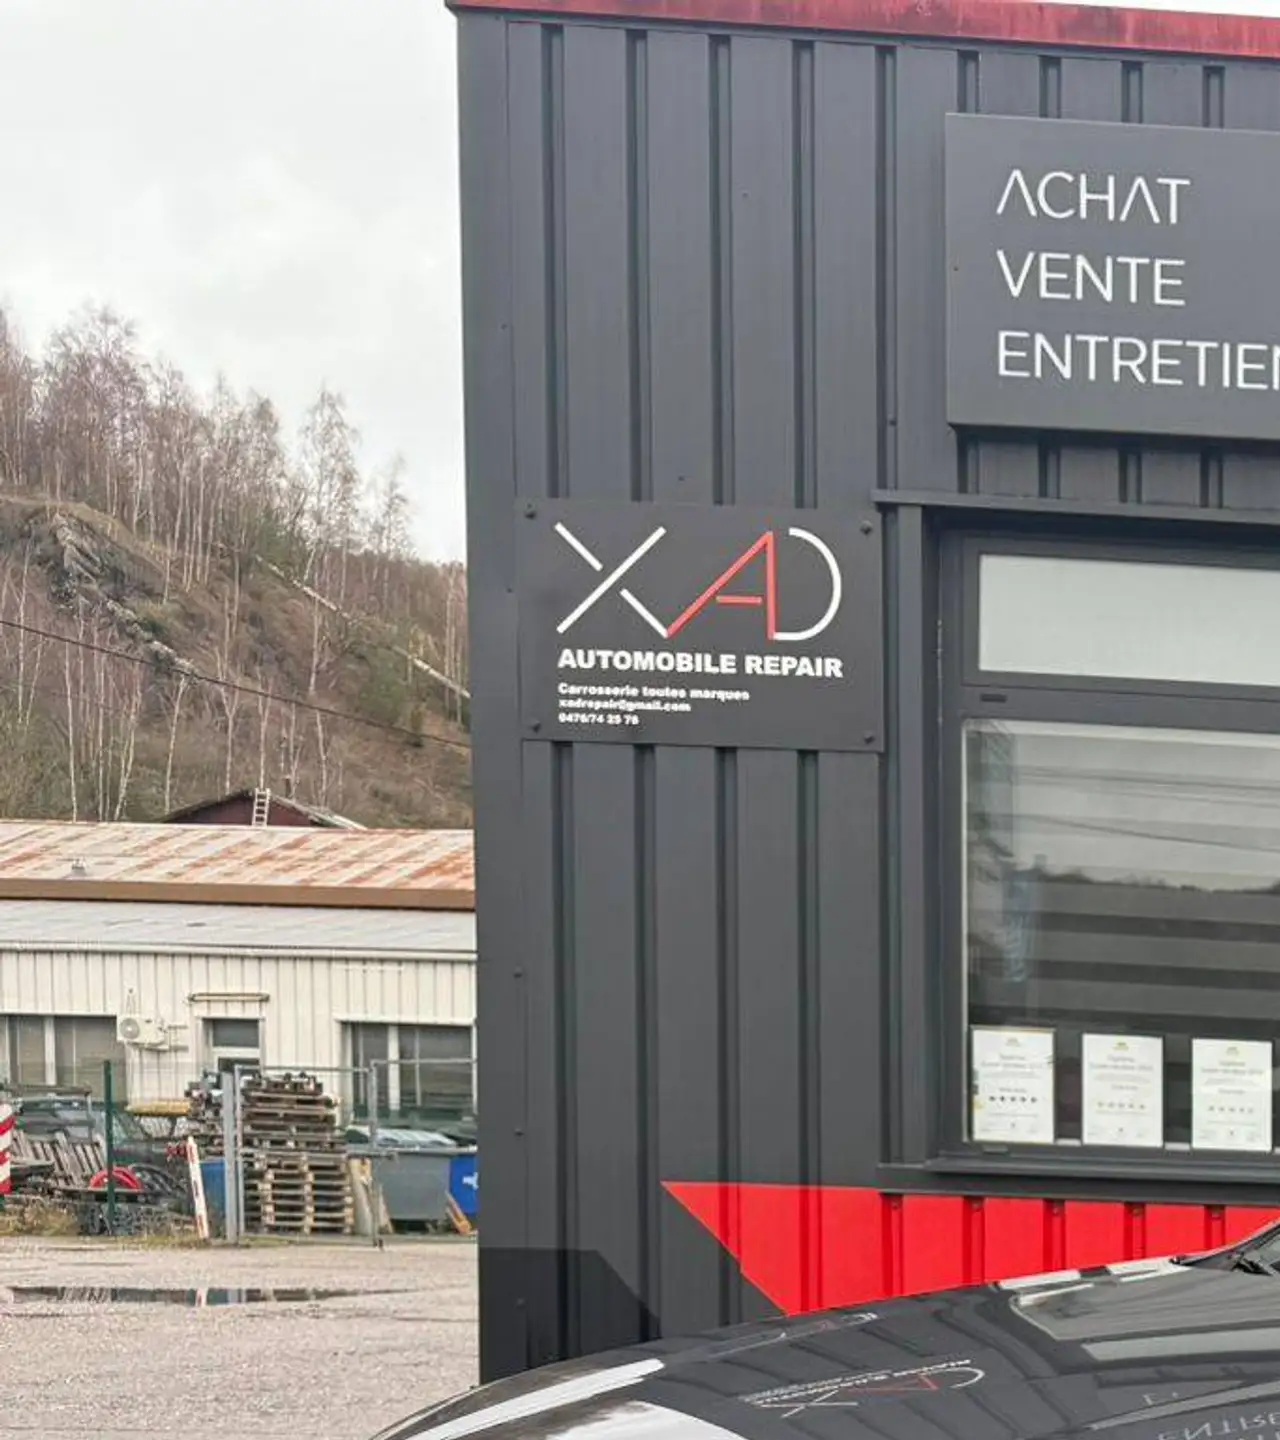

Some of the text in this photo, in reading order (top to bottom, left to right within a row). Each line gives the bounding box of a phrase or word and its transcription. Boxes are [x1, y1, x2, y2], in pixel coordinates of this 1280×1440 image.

[996, 169, 1191, 225] ACHAT
[996, 249, 1186, 306] VENTE
[554, 521, 842, 641] XAD
[557, 649, 844, 678] AUTOMOBILE REPAIR
[558, 682, 750, 702] Carrosserie toutes marques
